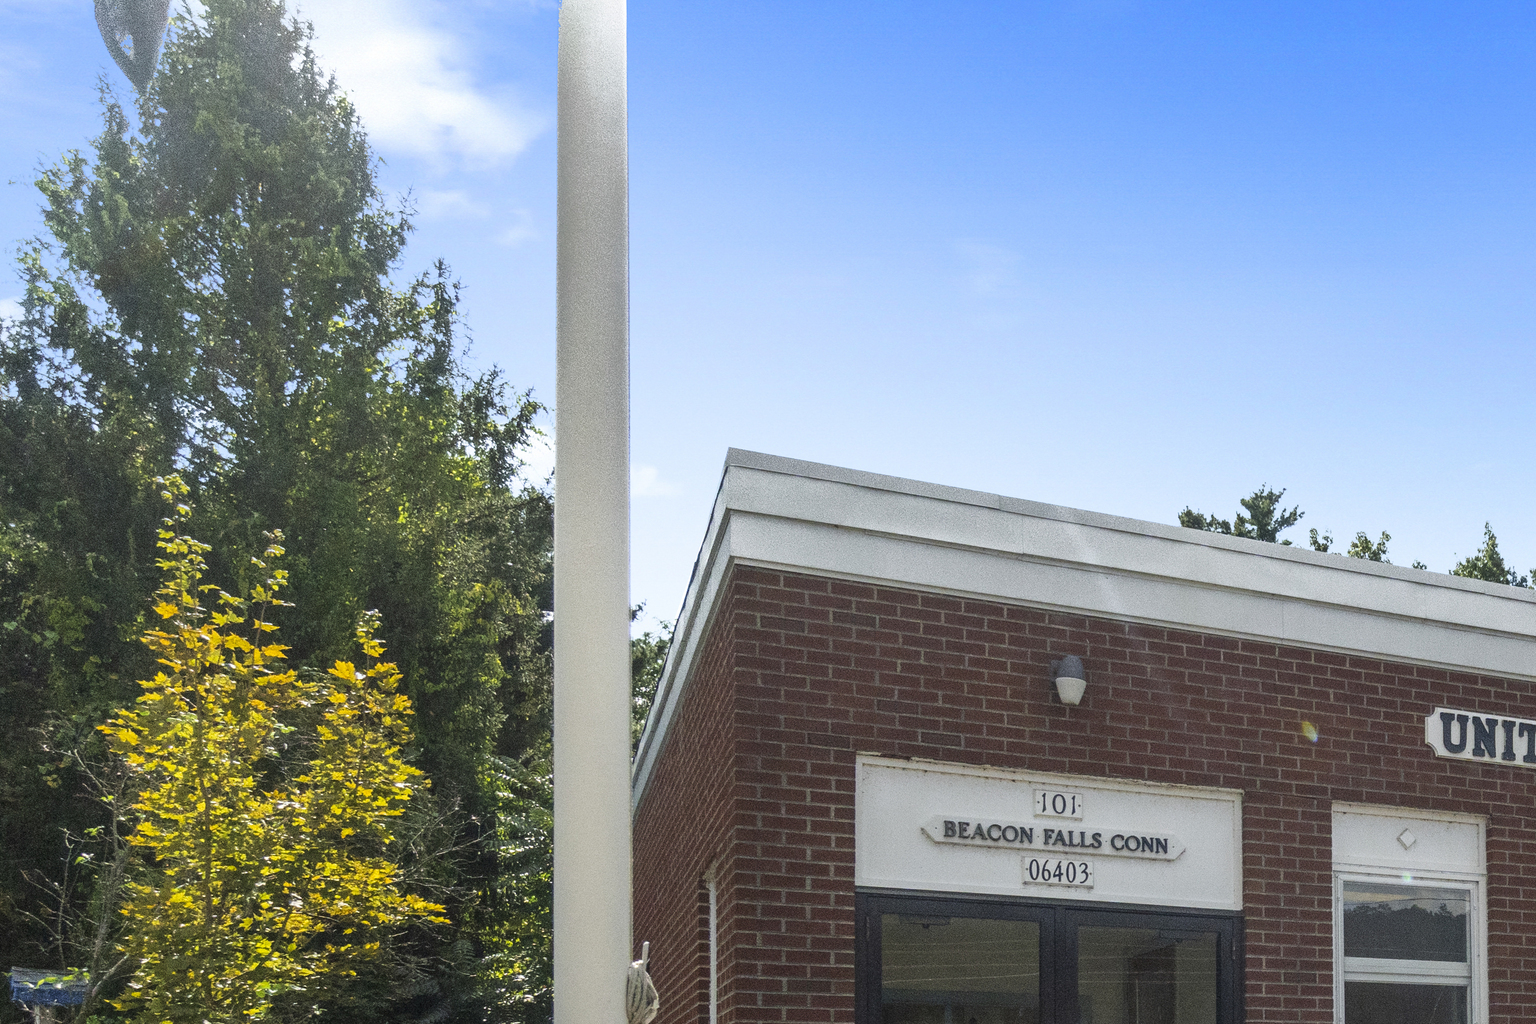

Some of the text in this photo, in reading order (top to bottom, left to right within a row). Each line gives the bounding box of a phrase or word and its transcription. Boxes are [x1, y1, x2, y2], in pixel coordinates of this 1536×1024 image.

[1041, 793, 1077, 815] 101
[943, 820, 1169, 854] BEACON FALLS CONN
[1029, 858, 1089, 883] 06403
